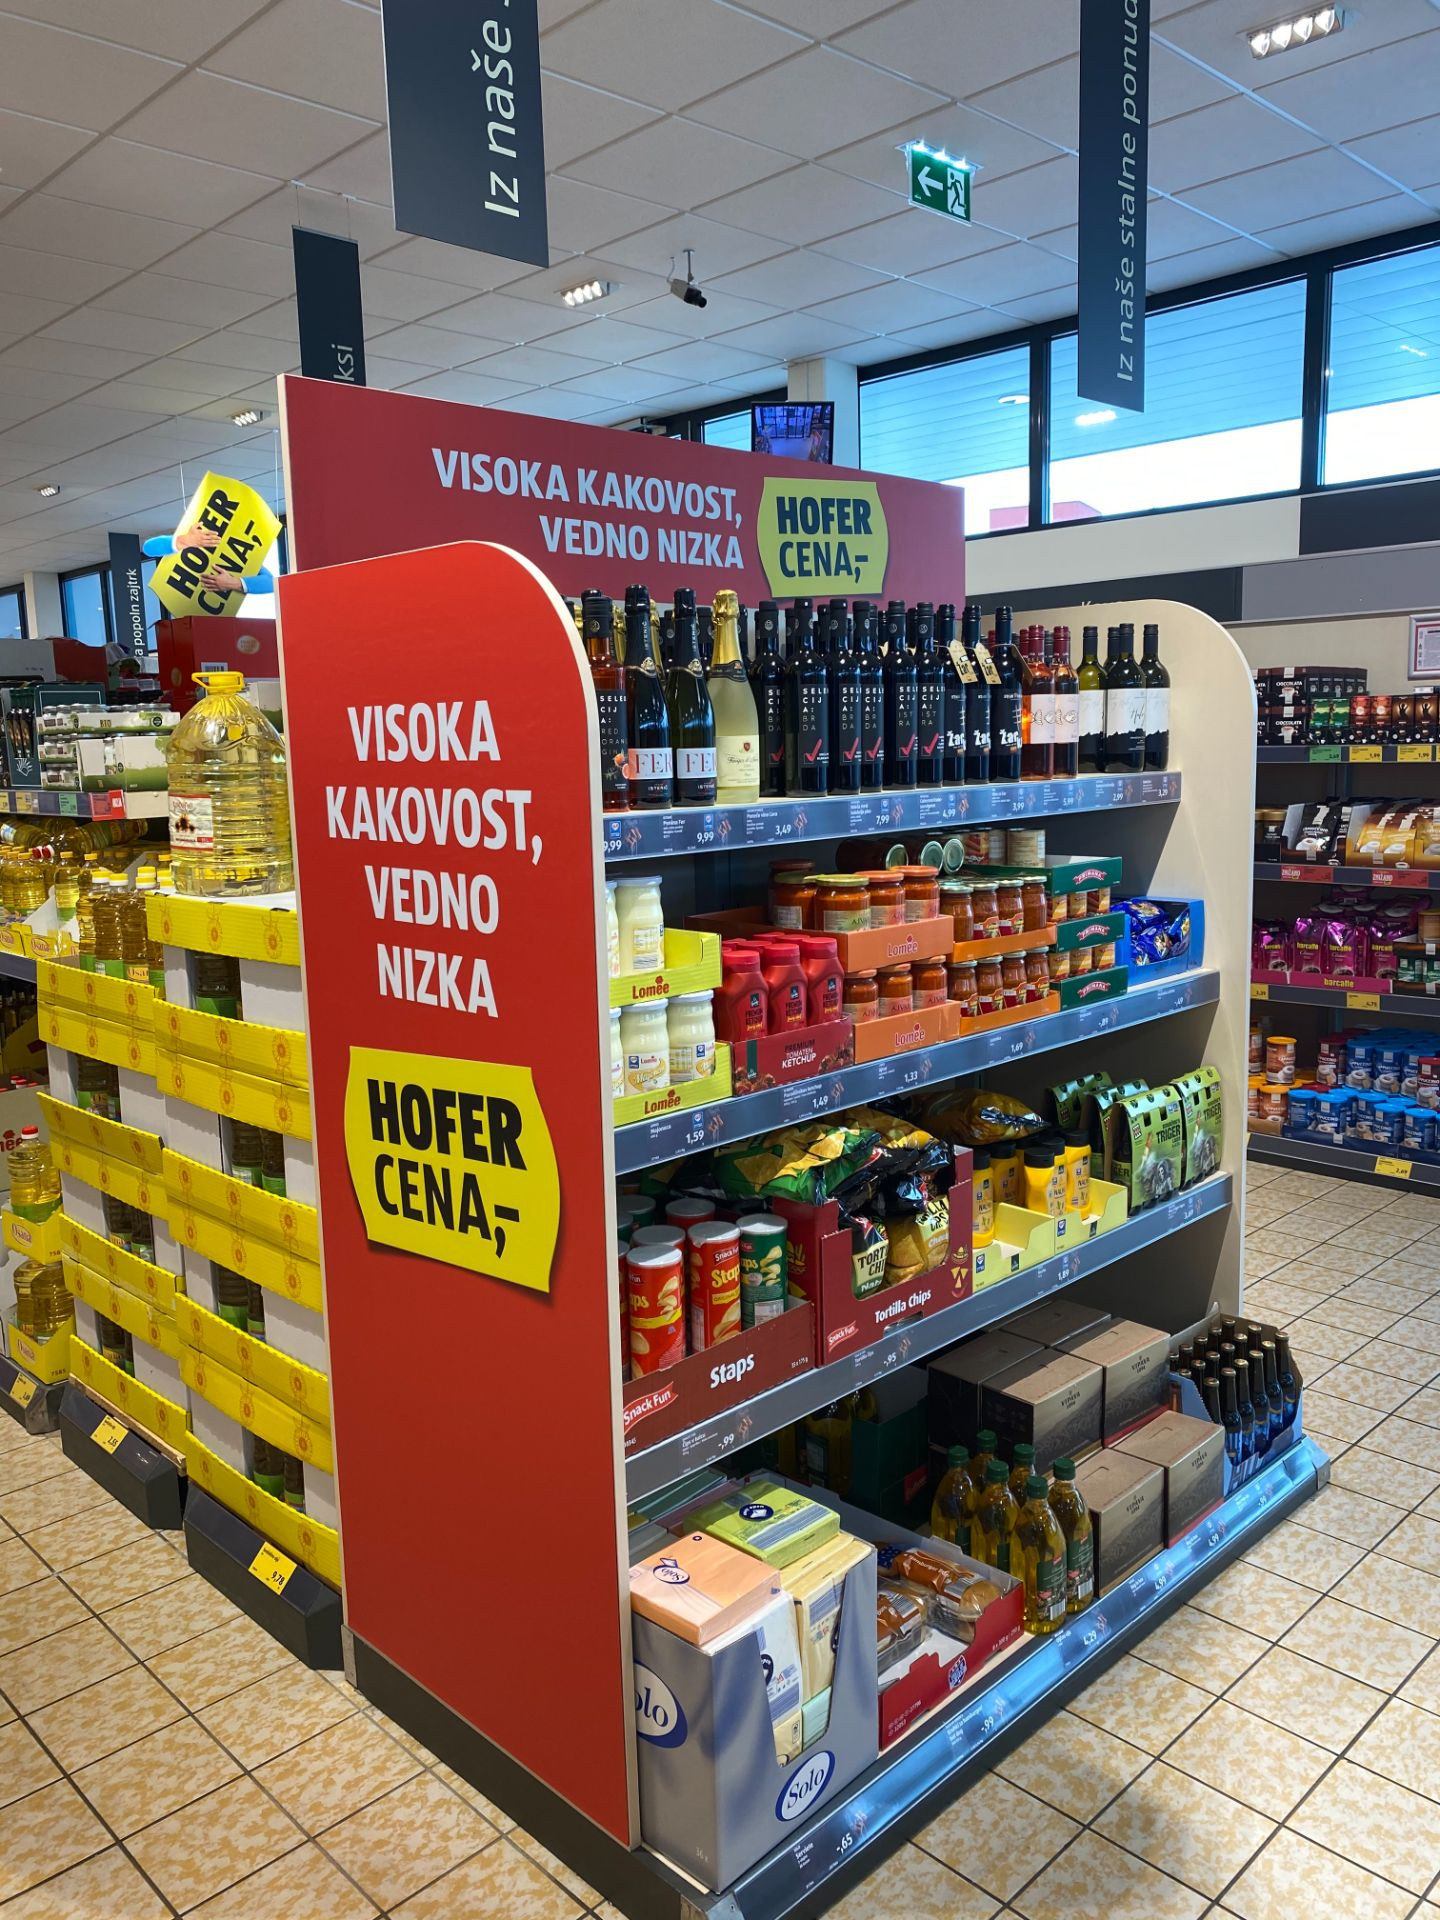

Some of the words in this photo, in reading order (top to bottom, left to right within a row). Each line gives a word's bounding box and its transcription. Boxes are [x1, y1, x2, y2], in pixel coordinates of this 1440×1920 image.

[471, 19, 518, 159] naše
[485, 170, 520, 218] Iz
[1117, 131, 1137, 251] stalne
[1114, 257, 1135, 348] naše
[332, 343, 355, 381] ksi
[1117, 356, 1133, 382] Iz
[432, 447, 570, 503] VISOKA
[578, 467, 742, 528] KAKOVOST,
[776, 495, 872, 537] HOFER
[166, 489, 240, 599] HOER
[540, 515, 650, 560] VEDNO
[659, 521, 744, 569] NIZKA
[779, 540, 870, 584] CENA,-
[198, 520, 263, 615] CNA,-
[347, 700, 501, 762] VISOKA
[325, 786, 543, 866] KAKOVOST,
[697, 831, 715, 844] 9,99
[775, 824, 792, 836] 3,49
[876, 814, 890, 826] 7,99
[364, 865, 500, 935] VEDNO
[376, 942, 499, 1018] NIZKA
[782, 1053, 817, 1069] KETCHUP
[904, 1071, 918, 1082] 1,33
[812, 1095, 828, 1109] 1,49
[367, 1079, 527, 1171] HOFER
[686, 1130, 704, 1144] 1,59
[374, 1154, 520, 1259] CENA,-
[874, 1298, 907, 1324] Tortilla
[908, 1289, 932, 1309] Chips
[710, 1353, 755, 1388] Staps
[623, 1398, 653, 1426] Snack
[653, 1390, 672, 1407] Fun
[271, 1569, 286, 1586] 9,78
[786, 1766, 826, 1810] Solo
[836, 1832, 853, 1855] -,65
